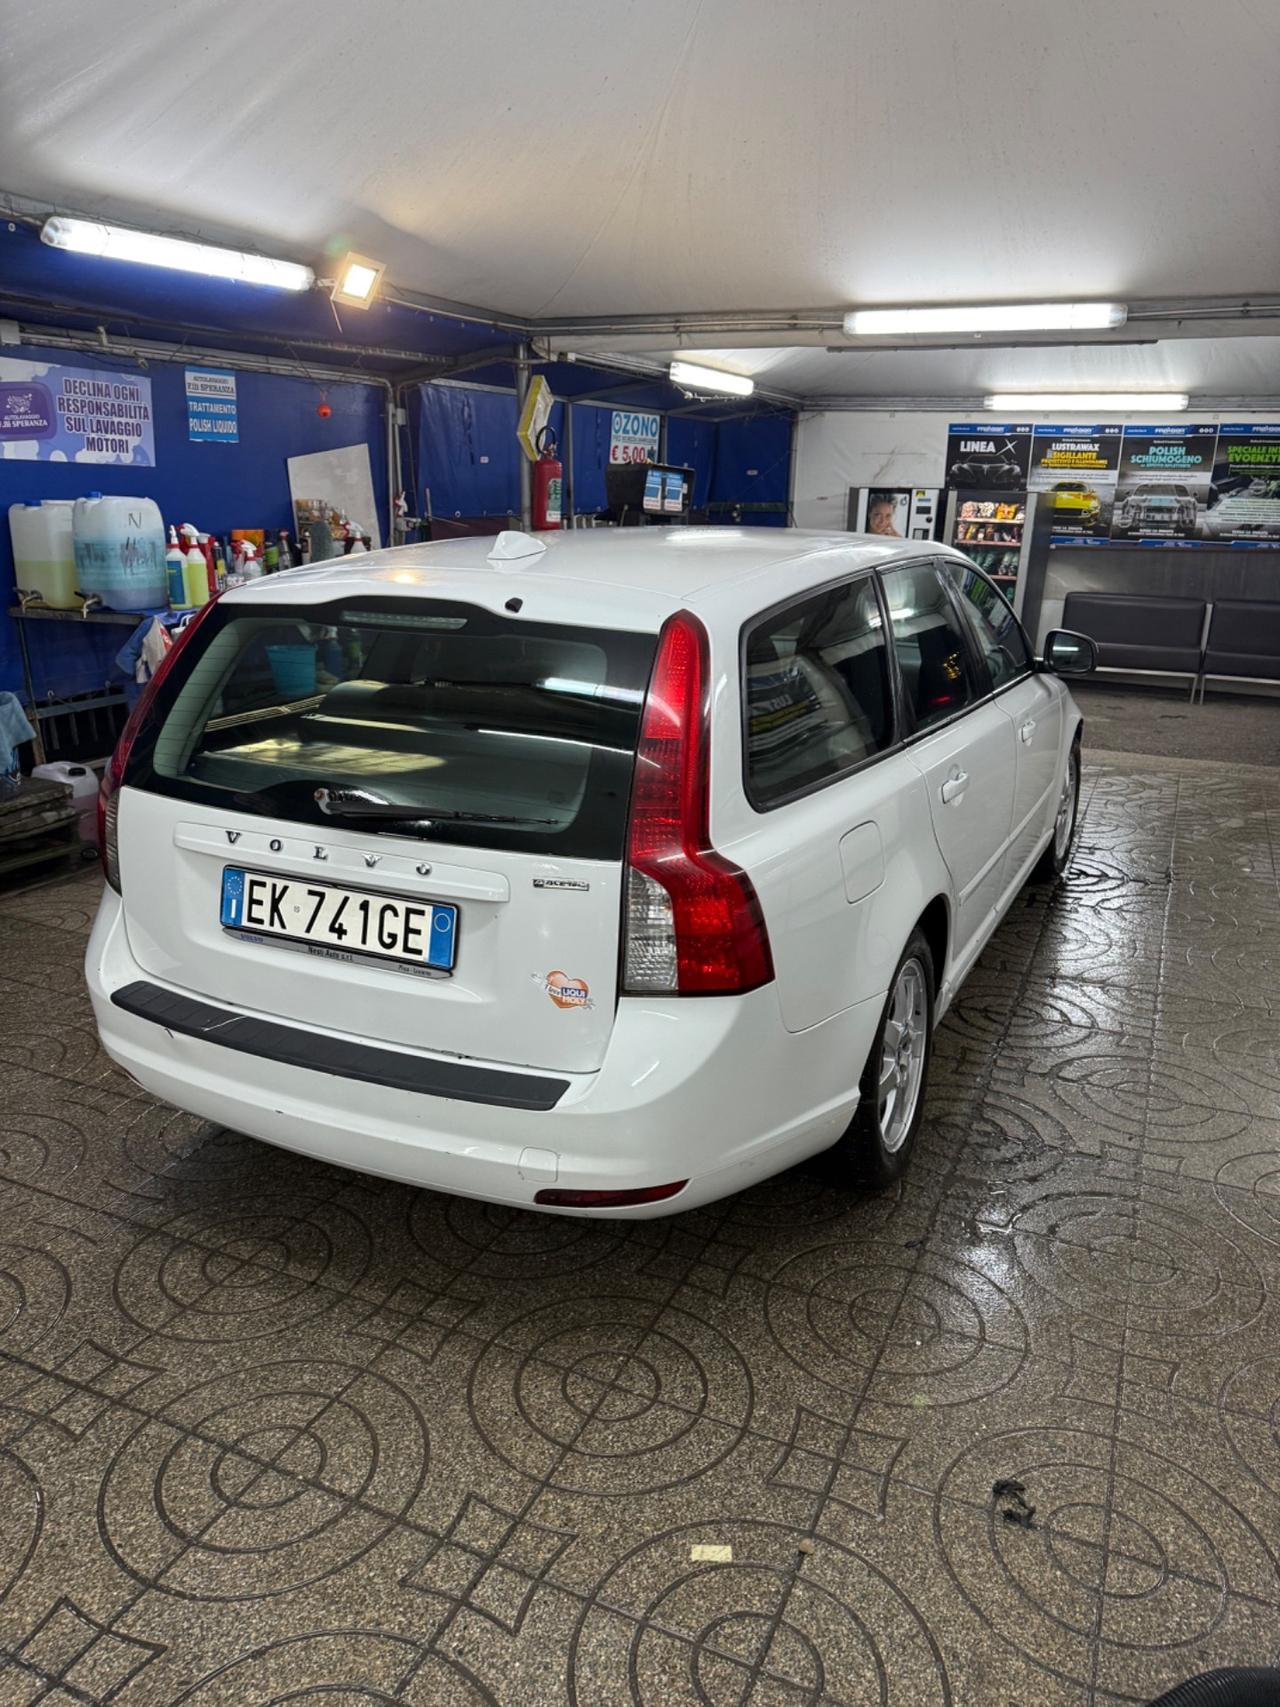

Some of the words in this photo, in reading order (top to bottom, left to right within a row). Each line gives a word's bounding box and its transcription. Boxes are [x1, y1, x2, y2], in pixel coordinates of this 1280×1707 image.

[64, 379, 111, 399] DECLINA
[114, 385, 139, 402] OGNI
[58, 397, 150, 420] RESPONSABILITÀ
[189, 402, 236, 414] TRATTAMENTO
[12, 419, 48, 428] SPERANZA
[66, 416, 87, 433] SUL
[90, 419, 142, 437] LAVAGGIO
[190, 418, 211, 432] POLISH
[213, 420, 237, 433] LIQUIDO
[613, 413, 658, 437] OZONO
[86, 437, 129, 453] MOTORI
[612, 445, 619, 461] €
[960, 441, 996, 453] LINEA
[995, 439, 1018, 456] X
[1052, 443, 1100, 451] LUSTRAWAX
[1149, 447, 1186, 455] POLISH
[1053, 451, 1097, 460] SIGILLANTE
[1131, 455, 1202, 464] SCHIUMOGENO
[226, 831, 432, 876] VOLVO
[247, 879, 289, 930] EK
[305, 889, 425, 956] 741GE
[562, 988, 586, 998] LIQUI
